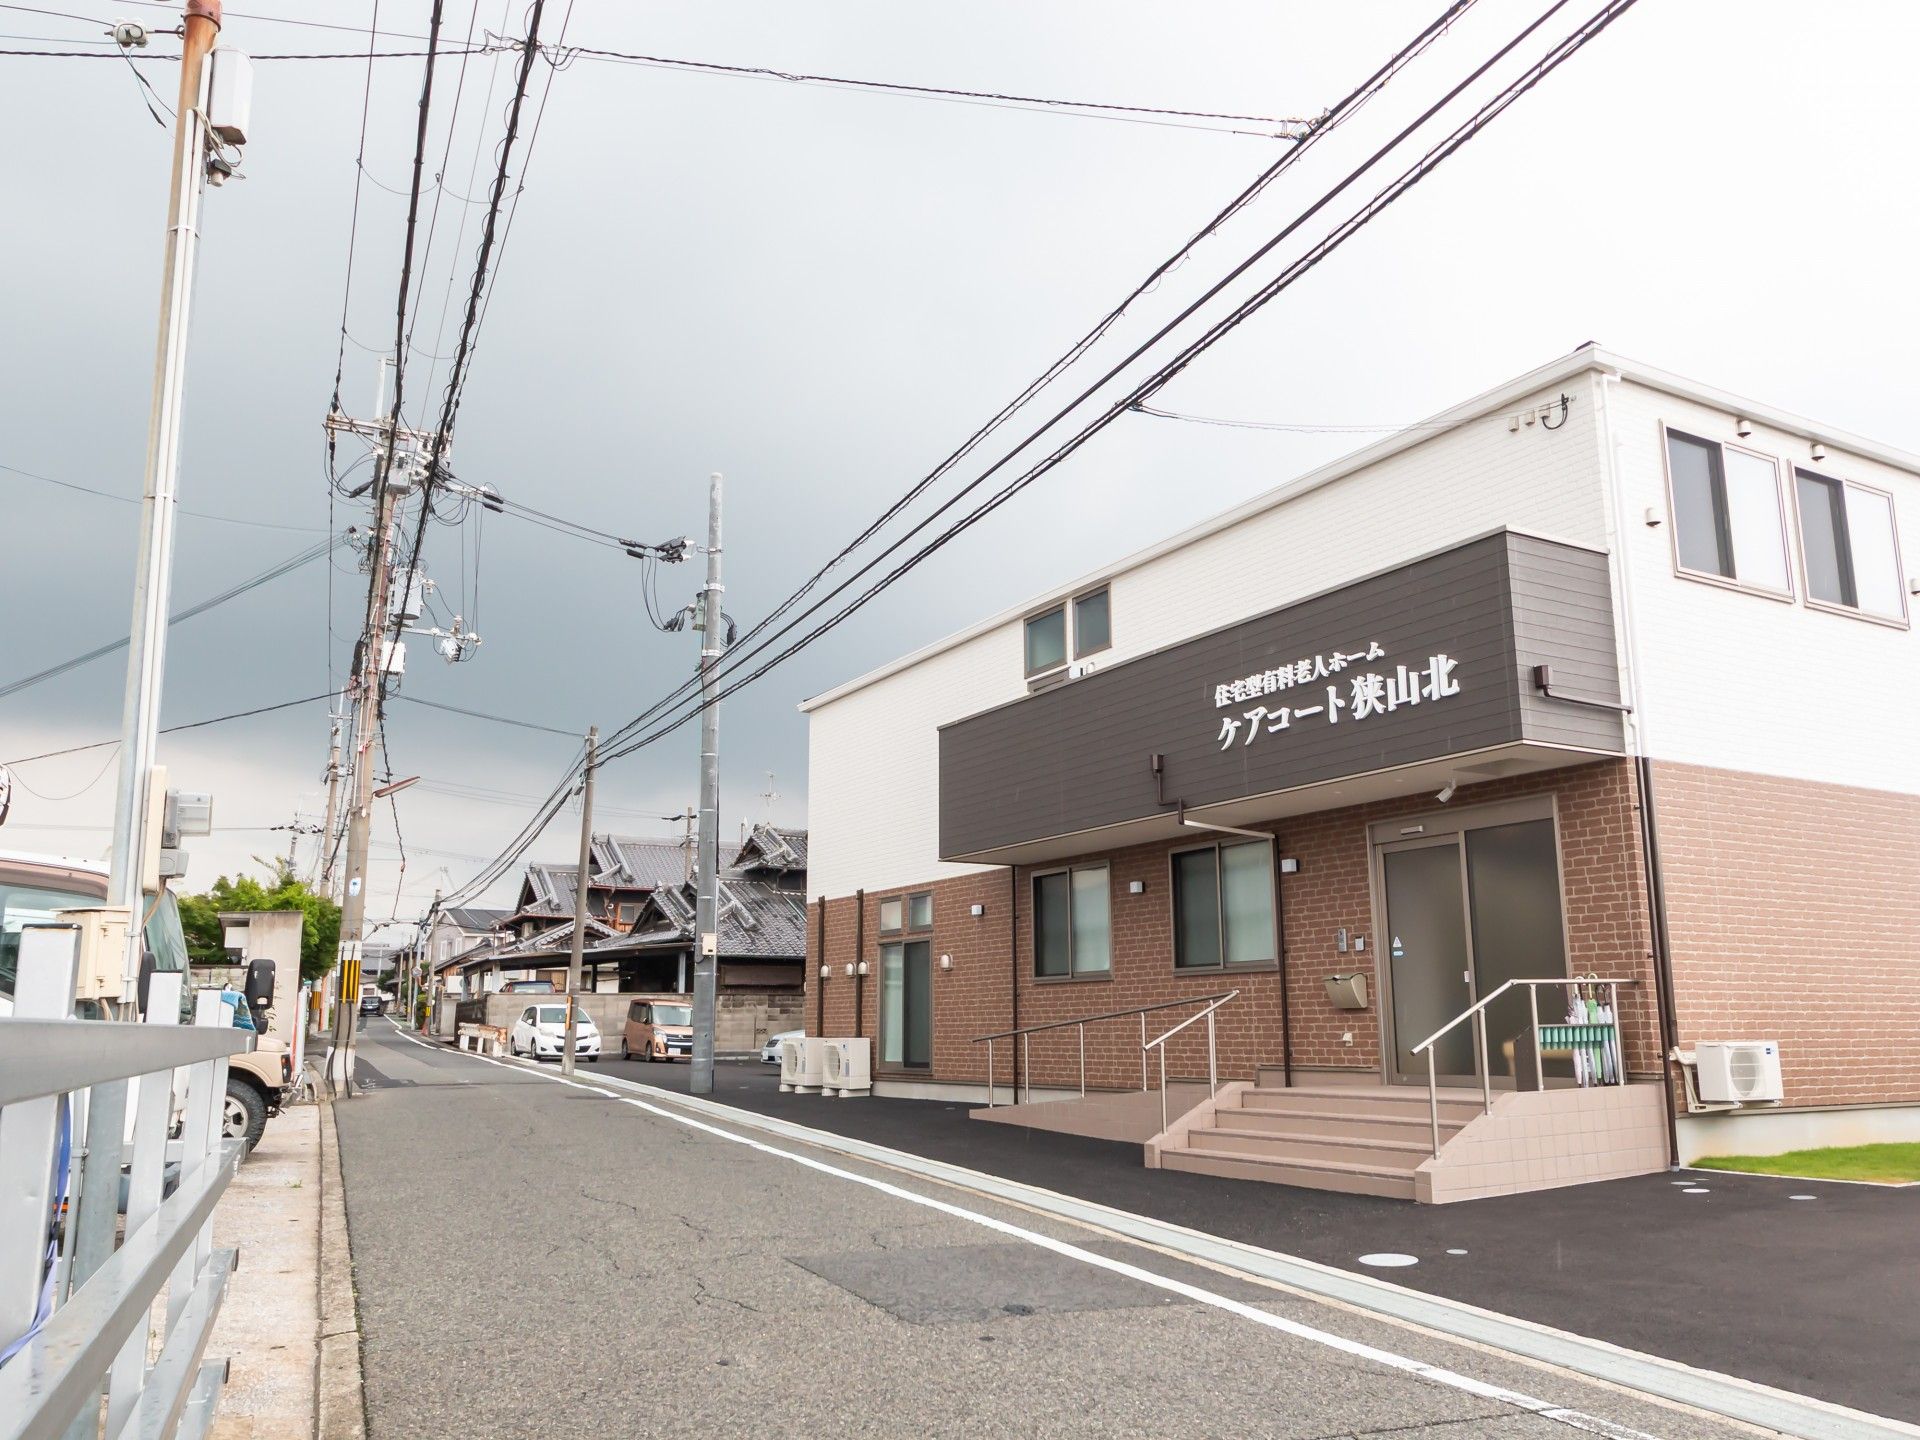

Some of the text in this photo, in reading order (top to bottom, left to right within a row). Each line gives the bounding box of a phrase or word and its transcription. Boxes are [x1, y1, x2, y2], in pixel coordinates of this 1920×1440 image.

[1214, 641, 1385, 708] 住宅型有料老人ホーム
[1217, 653, 1461, 751] ケアコート狭山北
